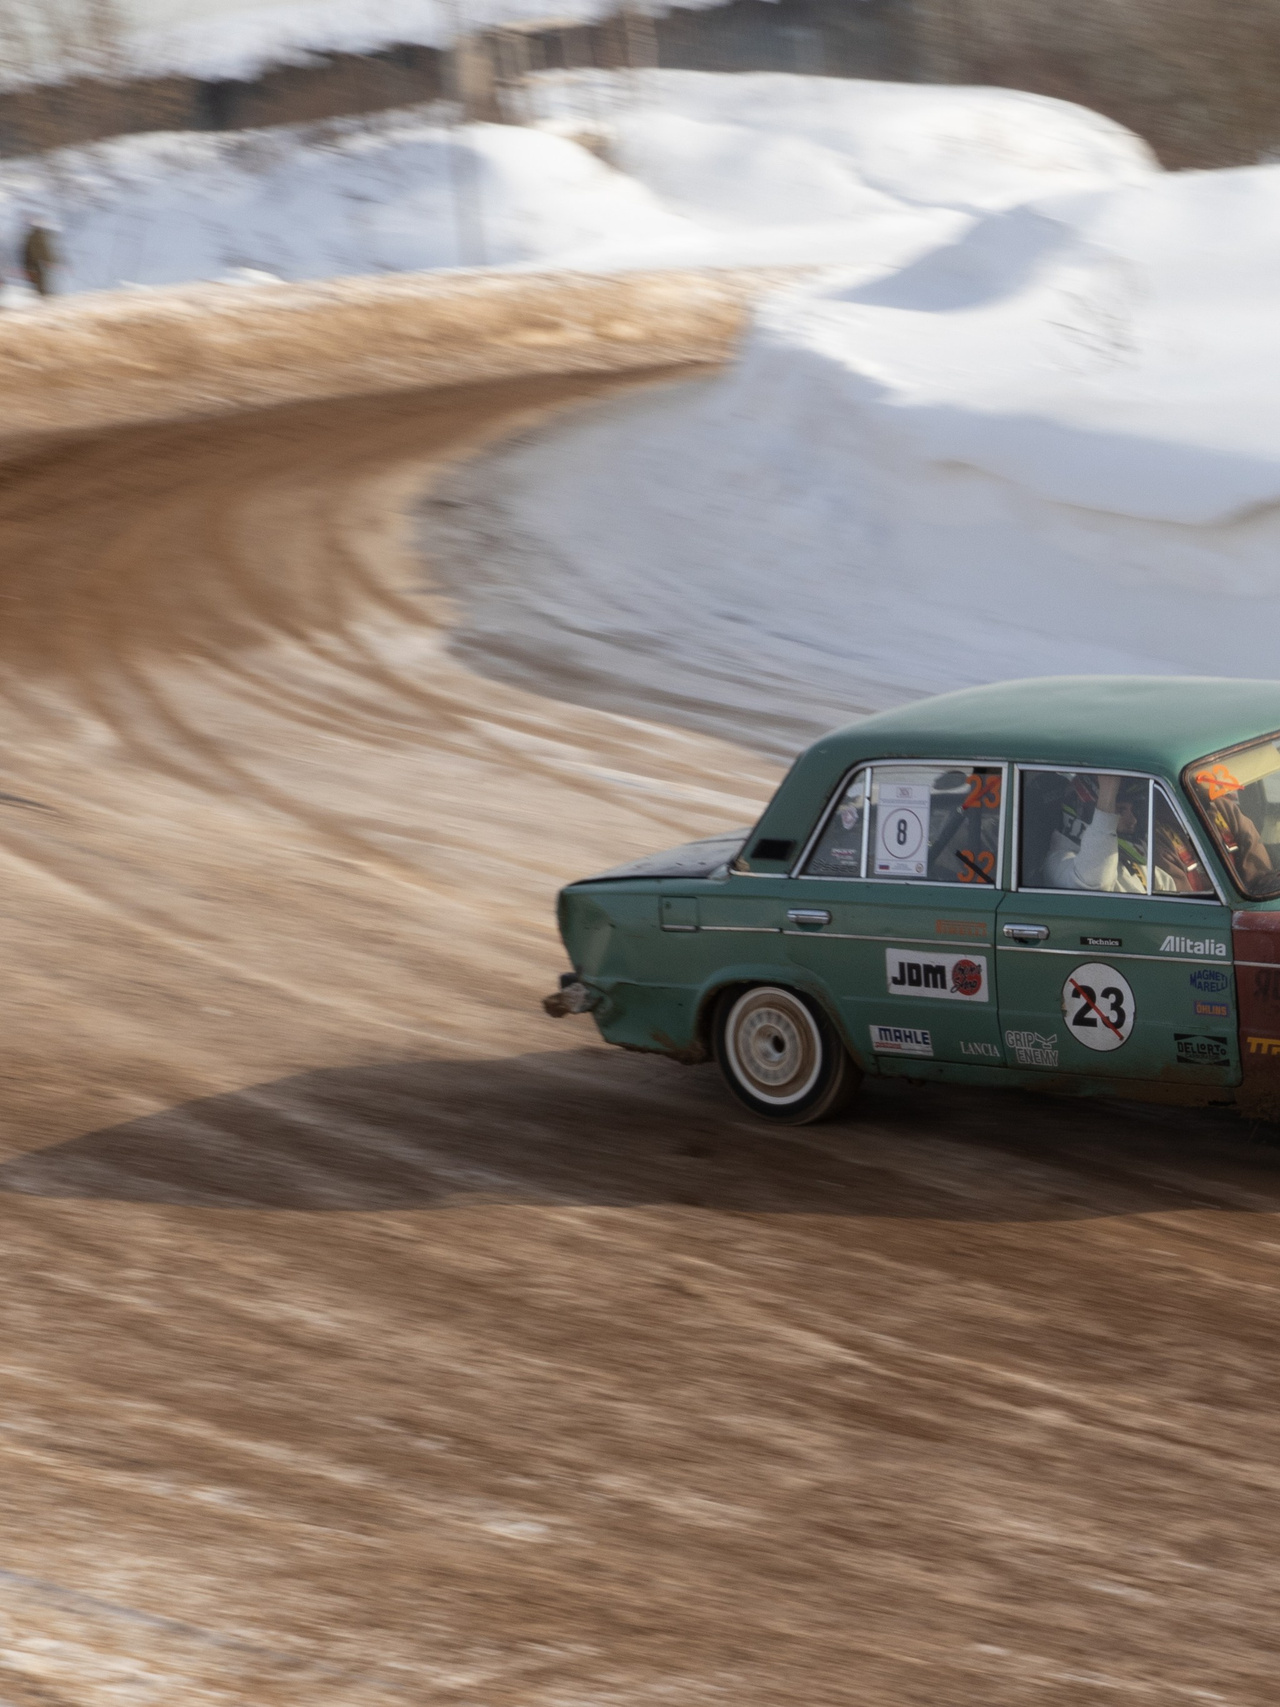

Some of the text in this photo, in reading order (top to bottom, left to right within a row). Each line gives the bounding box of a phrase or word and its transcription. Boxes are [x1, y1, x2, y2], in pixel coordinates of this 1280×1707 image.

[896, 818, 908, 846] 8
[1086, 937, 1120, 947] Technics
[1159, 935, 1227, 957] Alitalia
[891, 961, 947, 990] JDM
[1071, 984, 1126, 1030] 23
[877, 1027, 931, 1046] MAHLE
[1005, 1030, 1036, 1049] GRIP
[959, 1041, 1000, 1058] LANCIA
[1015, 1047, 1059, 1067] ENEMY
